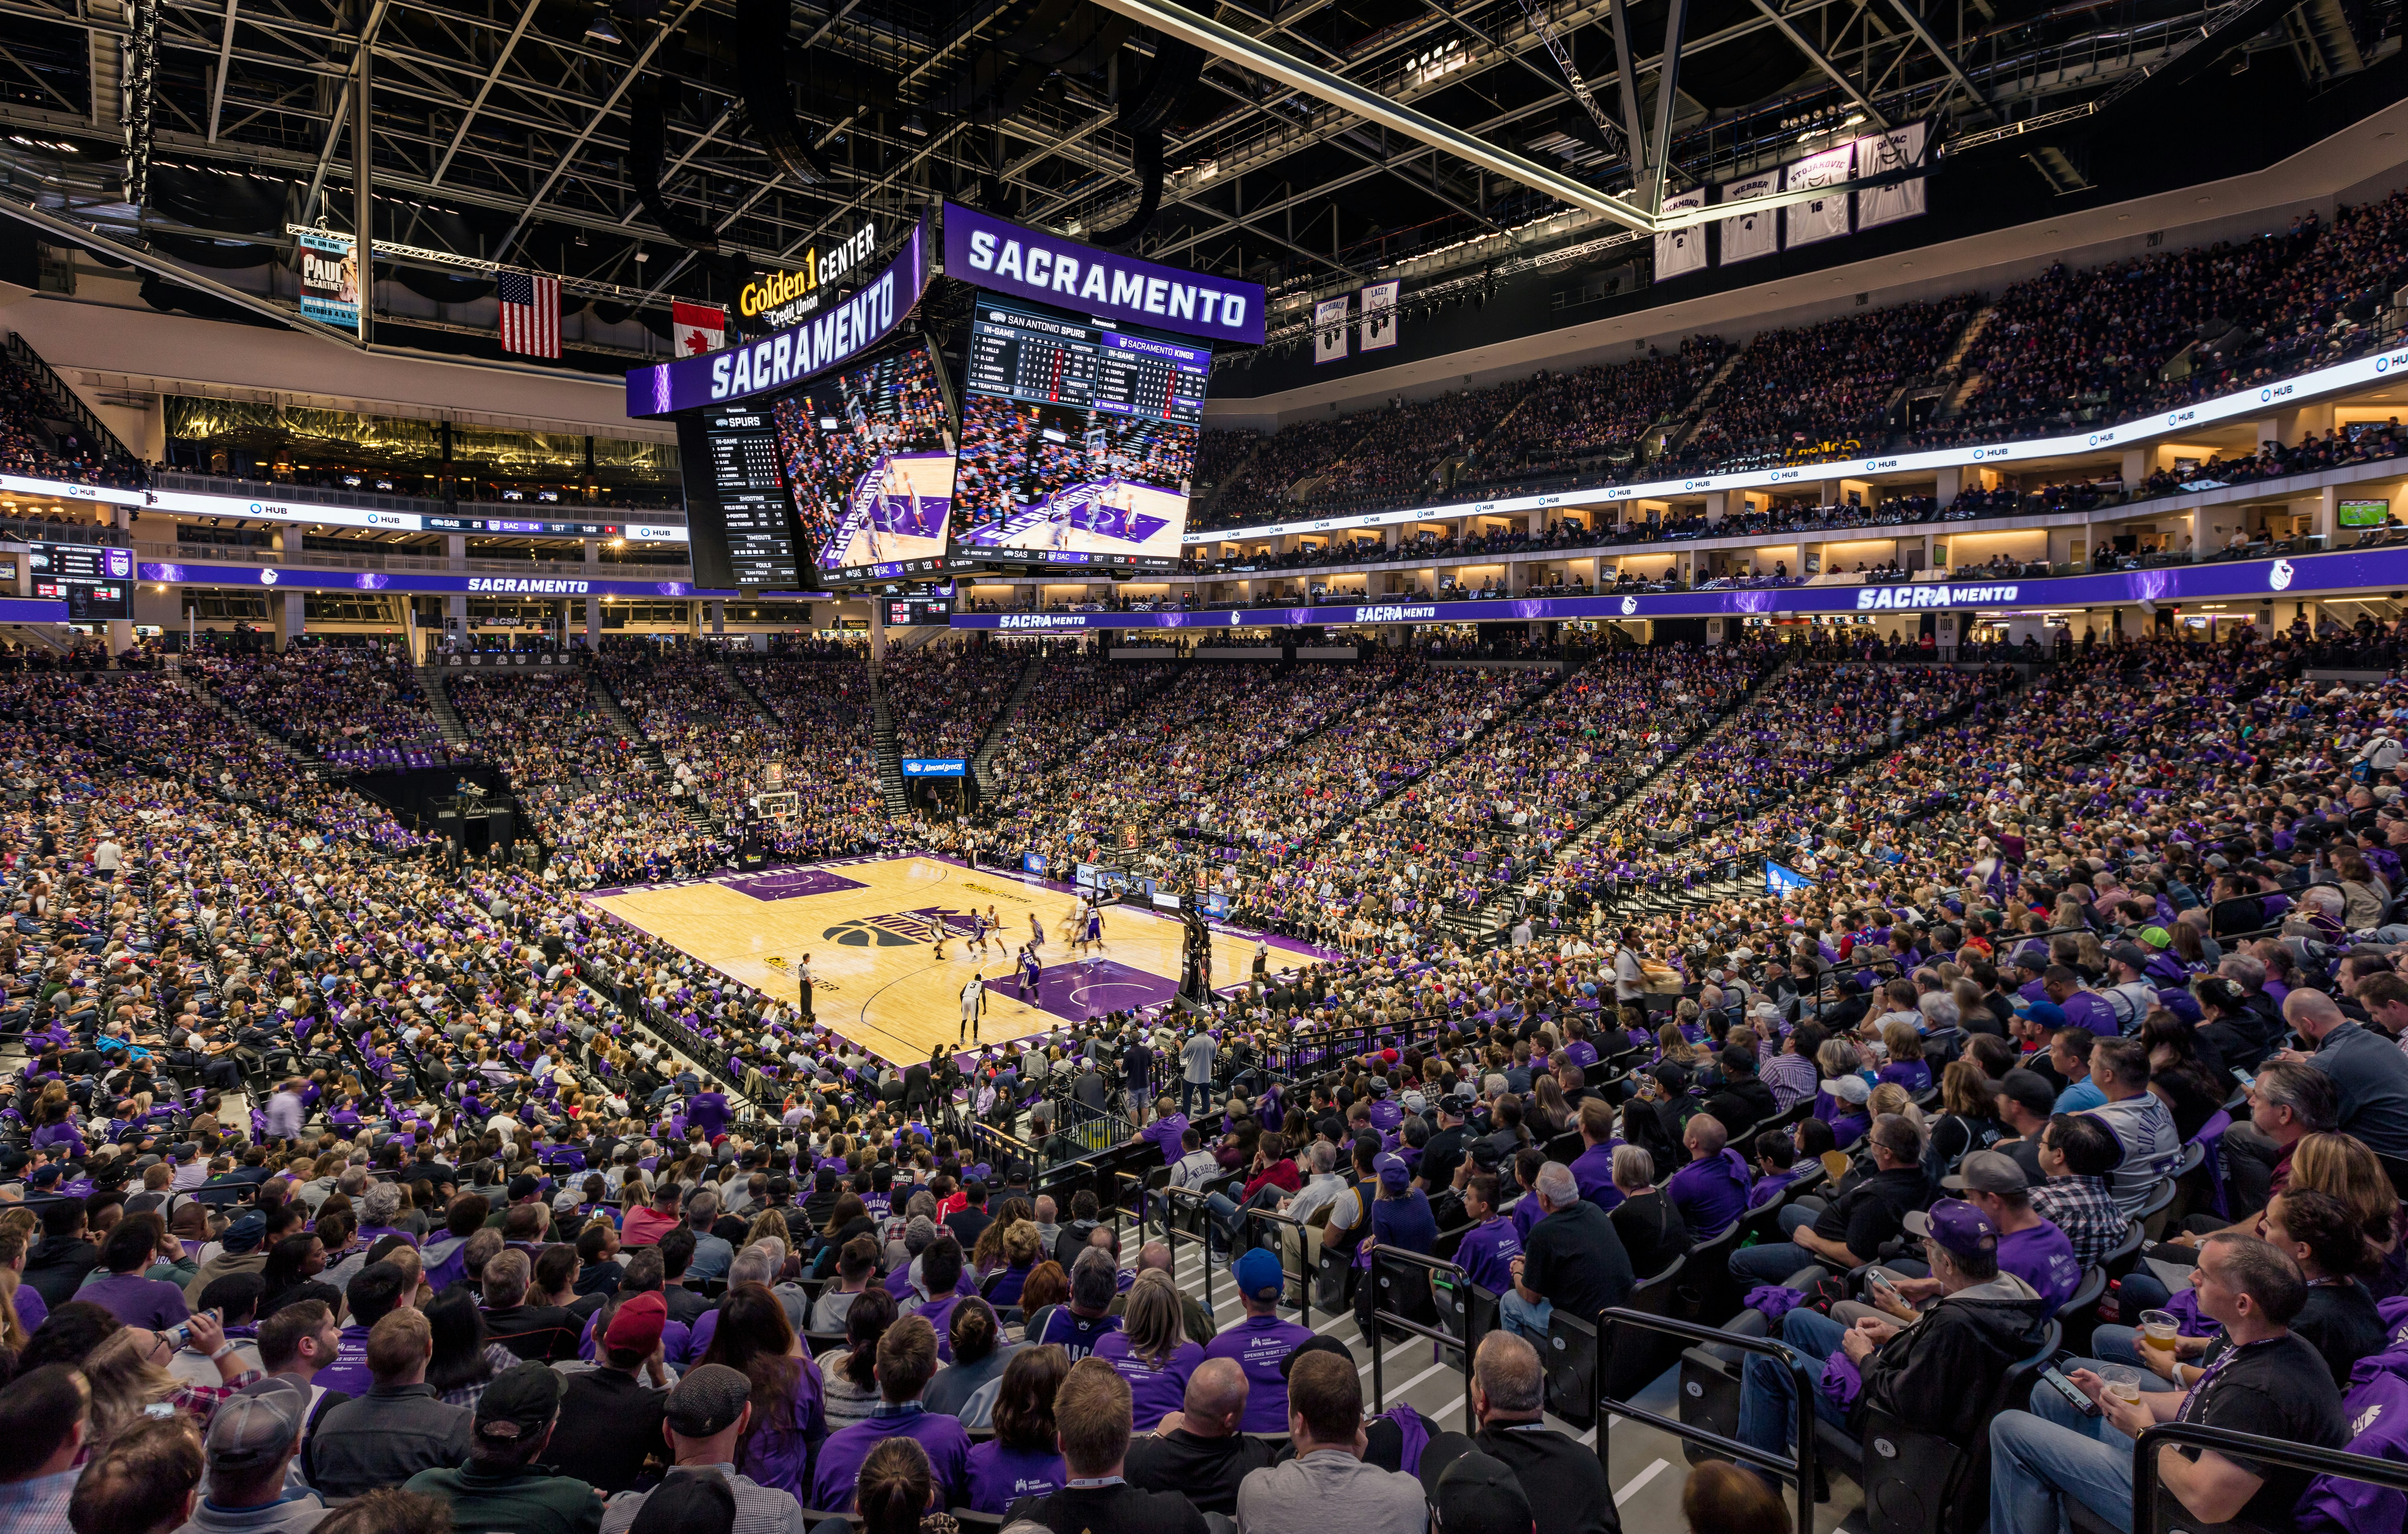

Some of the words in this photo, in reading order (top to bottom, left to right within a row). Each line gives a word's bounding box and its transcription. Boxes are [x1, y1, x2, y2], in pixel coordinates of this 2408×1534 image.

[1790, 161, 1845, 182] STOJAKOVIC
[1733, 181, 1768, 196] WEBBER
[1663, 198, 1698, 213] ICHMOND
[1810, 201, 1823, 213] 16
[1745, 220, 1753, 230] 4
[304, 238, 316, 246] ONE
[1676, 238, 1683, 248] 2
[819, 223, 875, 285] CENTER
[304, 257, 344, 283] PAUL
[304, 277, 344, 292] McCARTNEY
[968, 230, 1247, 328] SACRAMENTO
[1371, 287, 1388, 297] LACEY
[303, 299, 324, 307] GRAND
[326, 301, 351, 311] OPENING
[304, 306, 332, 316] OCTOBER
[771, 305, 795, 326] Credit
[795, 294, 818, 315] Union
[1320, 302, 1344, 315] ARCHIBALD
[1008, 315, 1025, 326] SAN
[1026, 319, 1059, 333] ANTONIO
[1061, 326, 1086, 338] SPURS
[1092, 318, 1117, 329] Panasonic
[711, 269, 894, 400] SACRAMENTO
[984, 325, 1015, 338] IN-GAME
[1071, 344, 1093, 353] SHOOTING
[1128, 340, 1173, 356] SACRAMENTO
[1174, 349, 1194, 360] KINGS
[1108, 349, 1135, 361] IN-GAME
[991, 384, 1009, 392] TOTALS
[1066, 380, 1088, 389] TIMEOUTS
[2274, 385, 2293, 397] HUB
[729, 417, 760, 427] SPURS
[2178, 411, 2194, 422] HUB
[2100, 433, 2114, 443] HUB
[1987, 448, 2008, 456] HUB
[444, 520, 460, 528] SAS
[852, 569, 861, 577] SAS
[867, 568, 873, 576] 21
[880, 566, 889, 574] SAC
[895, 564, 903, 573] 24
[906, 563, 914, 571] 1ST
[468, 578, 589, 593] SACRAMENTO
[1710, 623, 1719, 633] 108
[1940, 619, 1952, 630] 109
[923, 763, 944, 772] Almond
[944, 763, 962, 772] Breeze
[727, 859, 739, 870] SPALDING
[622, 856, 887, 894] SACRAMENTO
[996, 890, 1032, 903] CENTER
[1024, 957, 1035, 965] 43
[538, 1077, 545, 1087] 4
[865, 1199, 890, 1210] COUSINS
[2195, 1378, 2206, 1394] SEASON
[2185, 1390, 2196, 1405] TICKET
[1882, 1444, 1887, 1452] R
